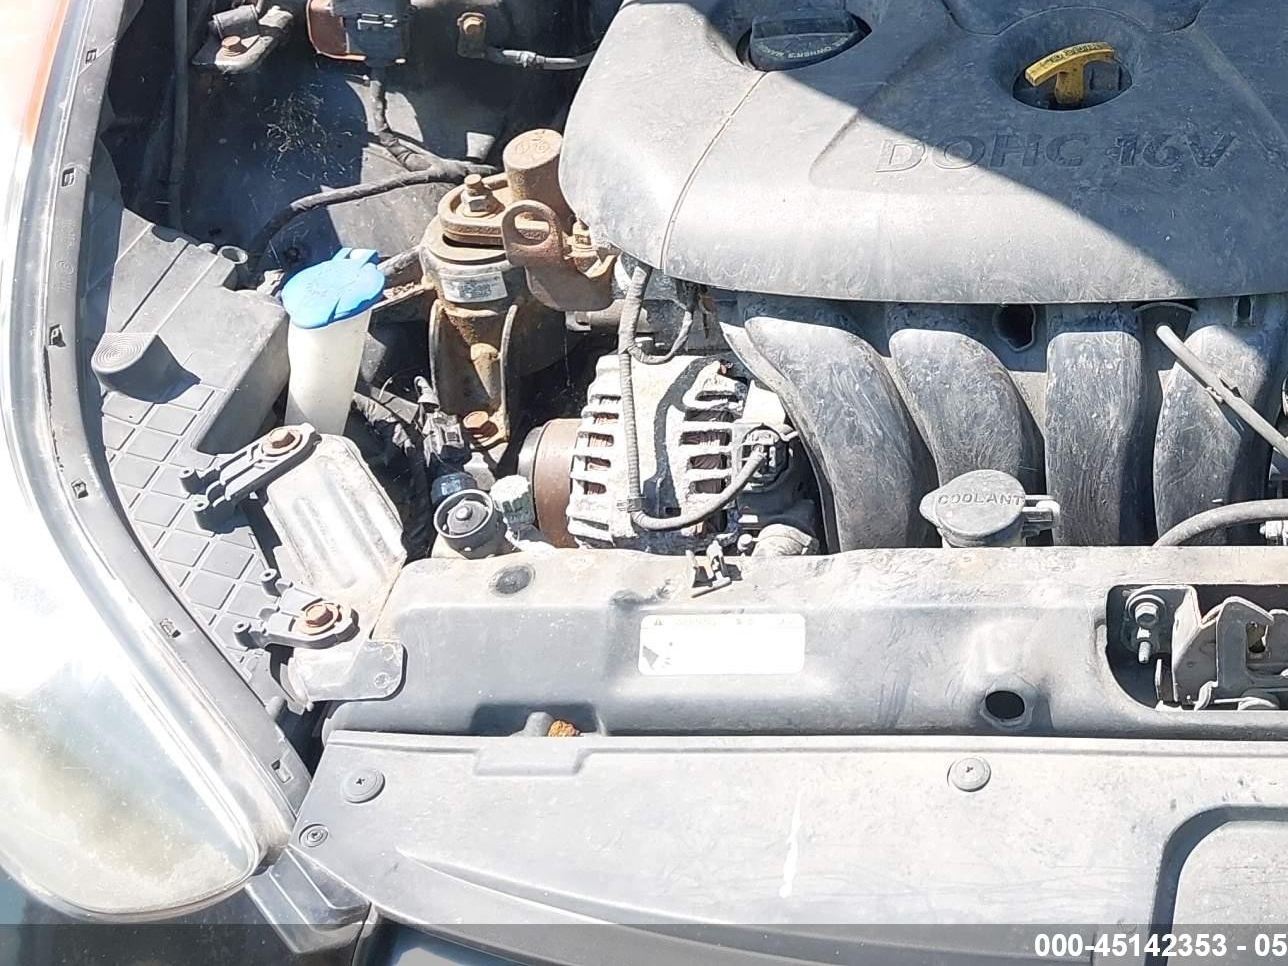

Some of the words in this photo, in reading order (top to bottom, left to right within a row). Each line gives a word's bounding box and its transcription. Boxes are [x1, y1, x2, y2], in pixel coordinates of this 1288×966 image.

[876, 133, 1086, 173] DOHC
[1108, 131, 1238, 170] 16V
[937, 492, 1025, 506] COOLANT
